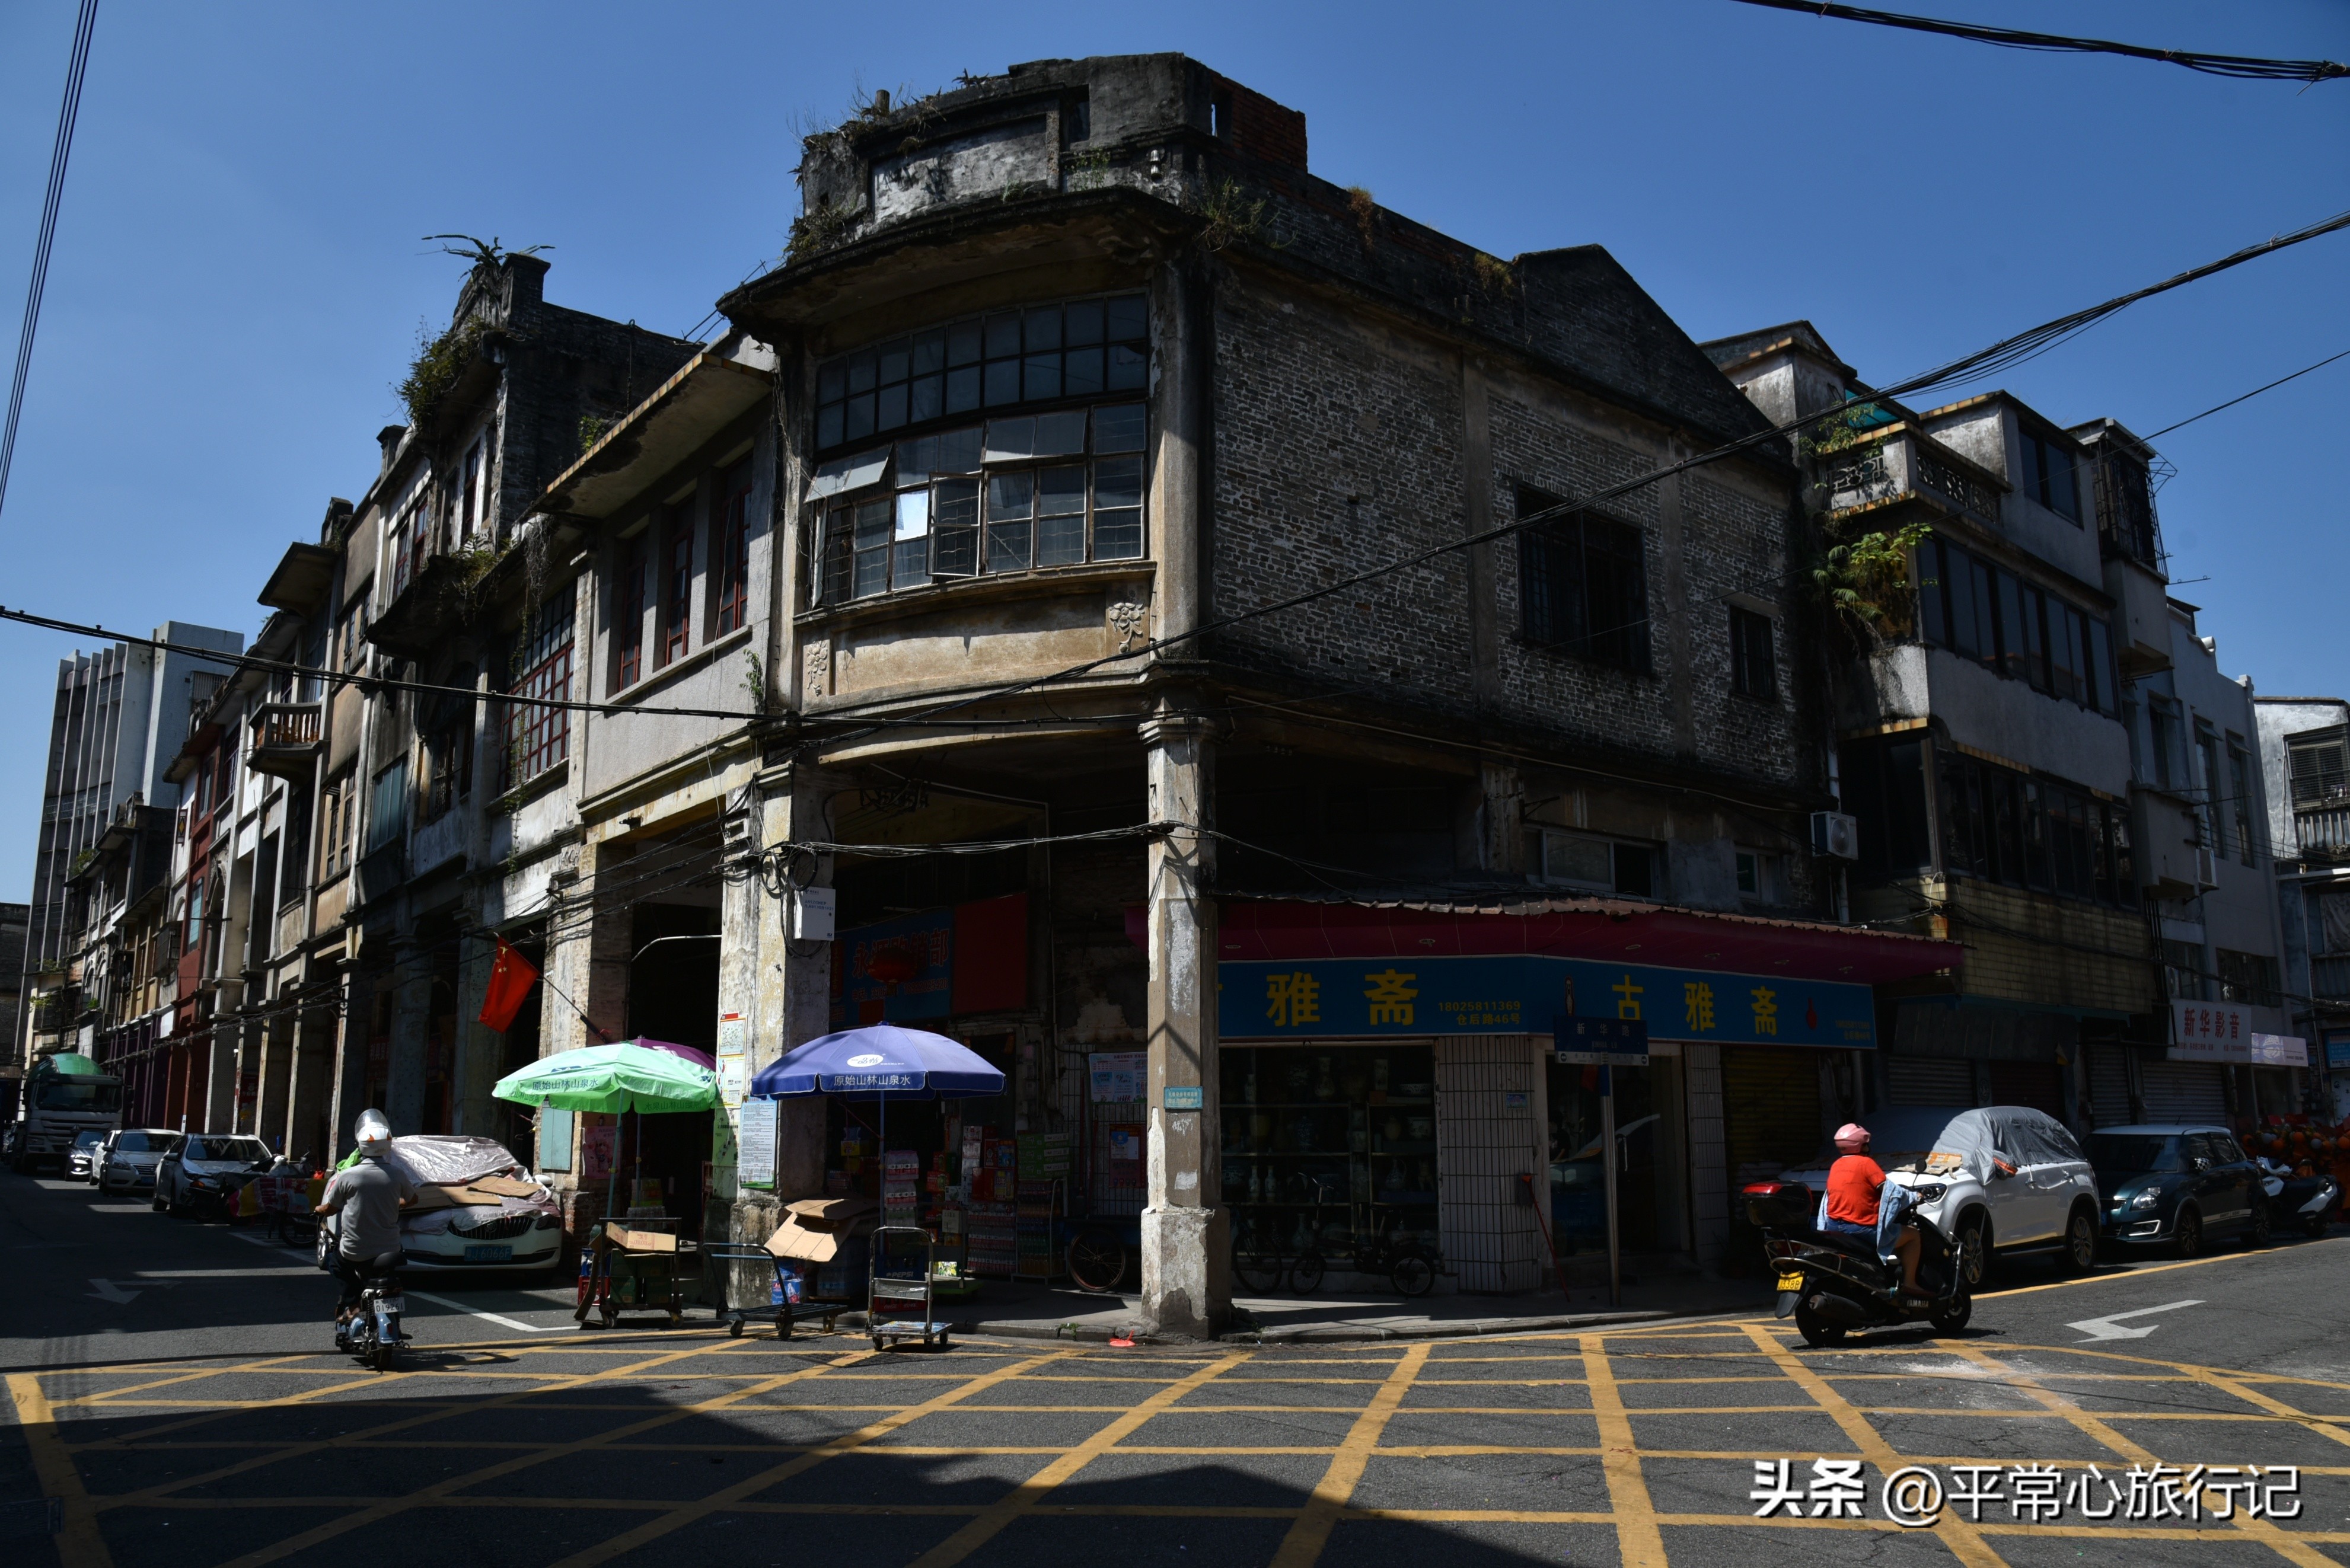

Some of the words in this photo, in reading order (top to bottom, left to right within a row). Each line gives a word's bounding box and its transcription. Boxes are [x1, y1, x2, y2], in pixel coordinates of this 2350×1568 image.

[1217, 969, 1419, 1027] 雅斋
[1438, 1001, 1521, 1011] 18025811369
[1612, 975, 1778, 1036] 古雅斋
[1456, 1013, 1521, 1026] 仓后路46号
[2184, 1008, 2239, 1039] 新华影音
[1577, 1022, 1630, 1037] 新华路
[533, 1078, 598, 1091] 原始山林山泉水
[834, 1075, 911, 1086] 原始山林山泉水
[376, 1302, 403, 1312] 019261
[1906, 1299, 1929, 1308] YAMAHA
